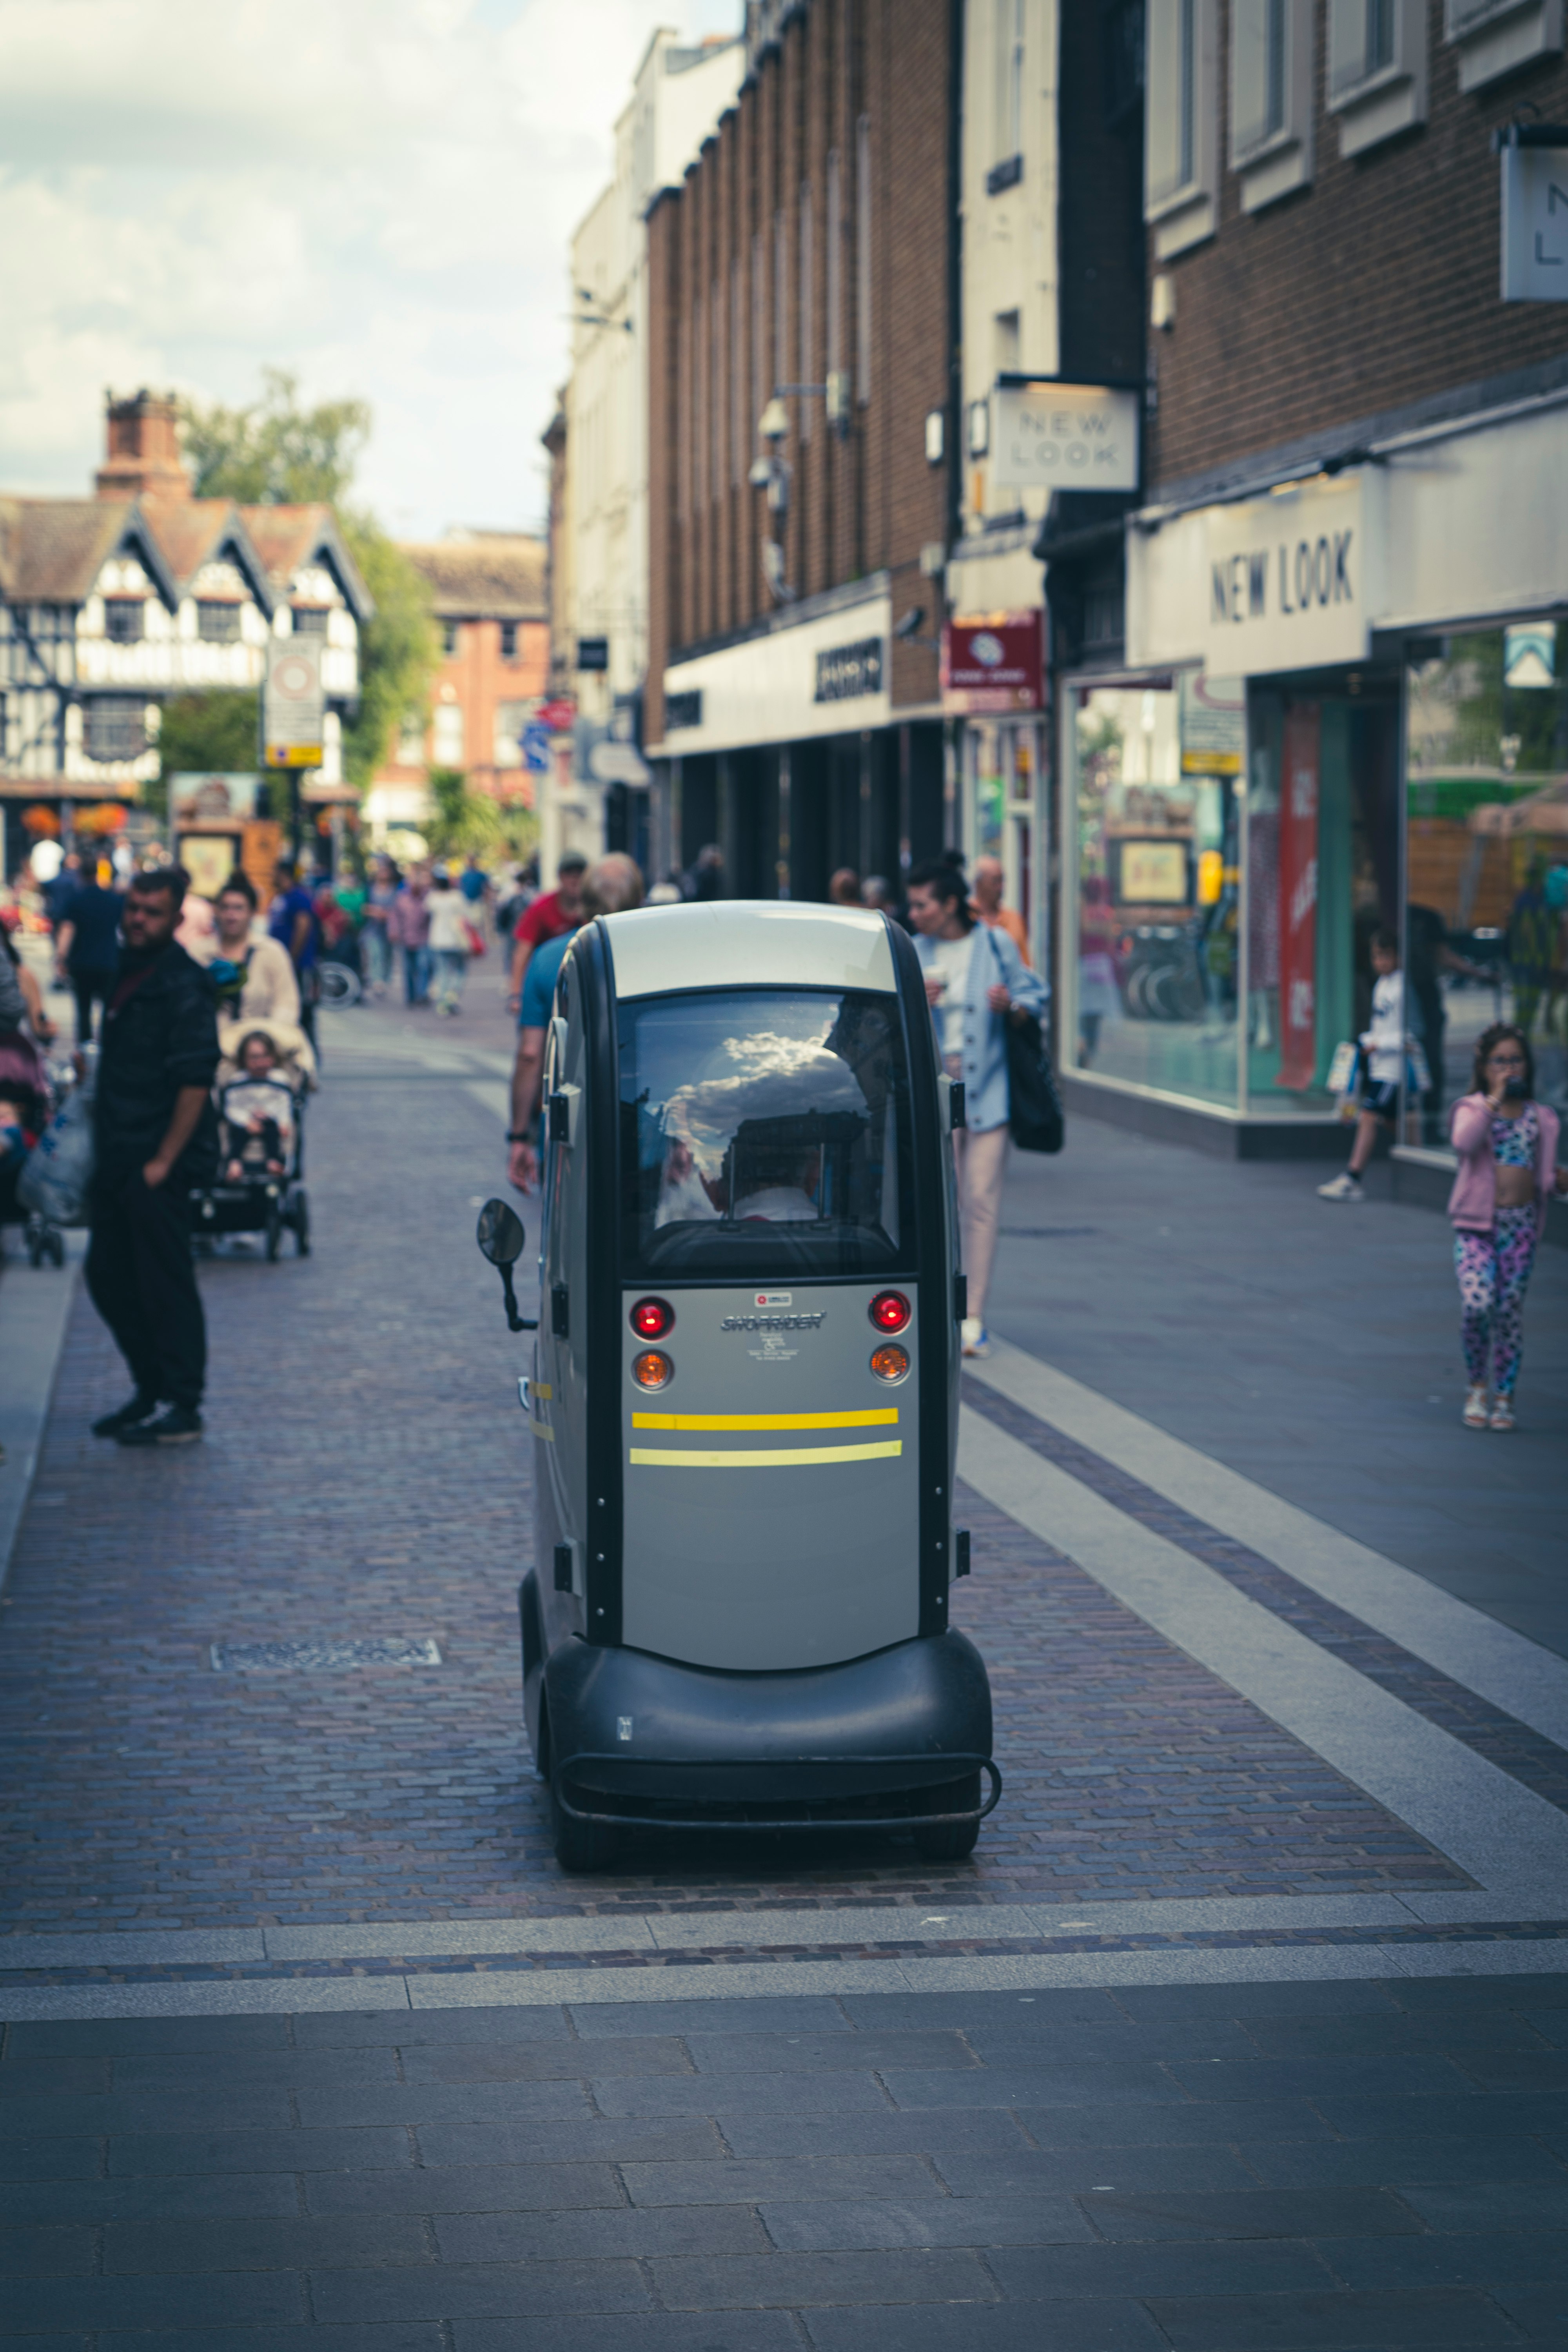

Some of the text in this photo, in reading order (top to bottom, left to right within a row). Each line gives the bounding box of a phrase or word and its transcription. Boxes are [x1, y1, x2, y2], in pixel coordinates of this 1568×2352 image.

[1021, 411, 1112, 437] NEW
[1011, 441, 1120, 468] LOOK
[1211, 528, 1353, 627] NEW LOOK
